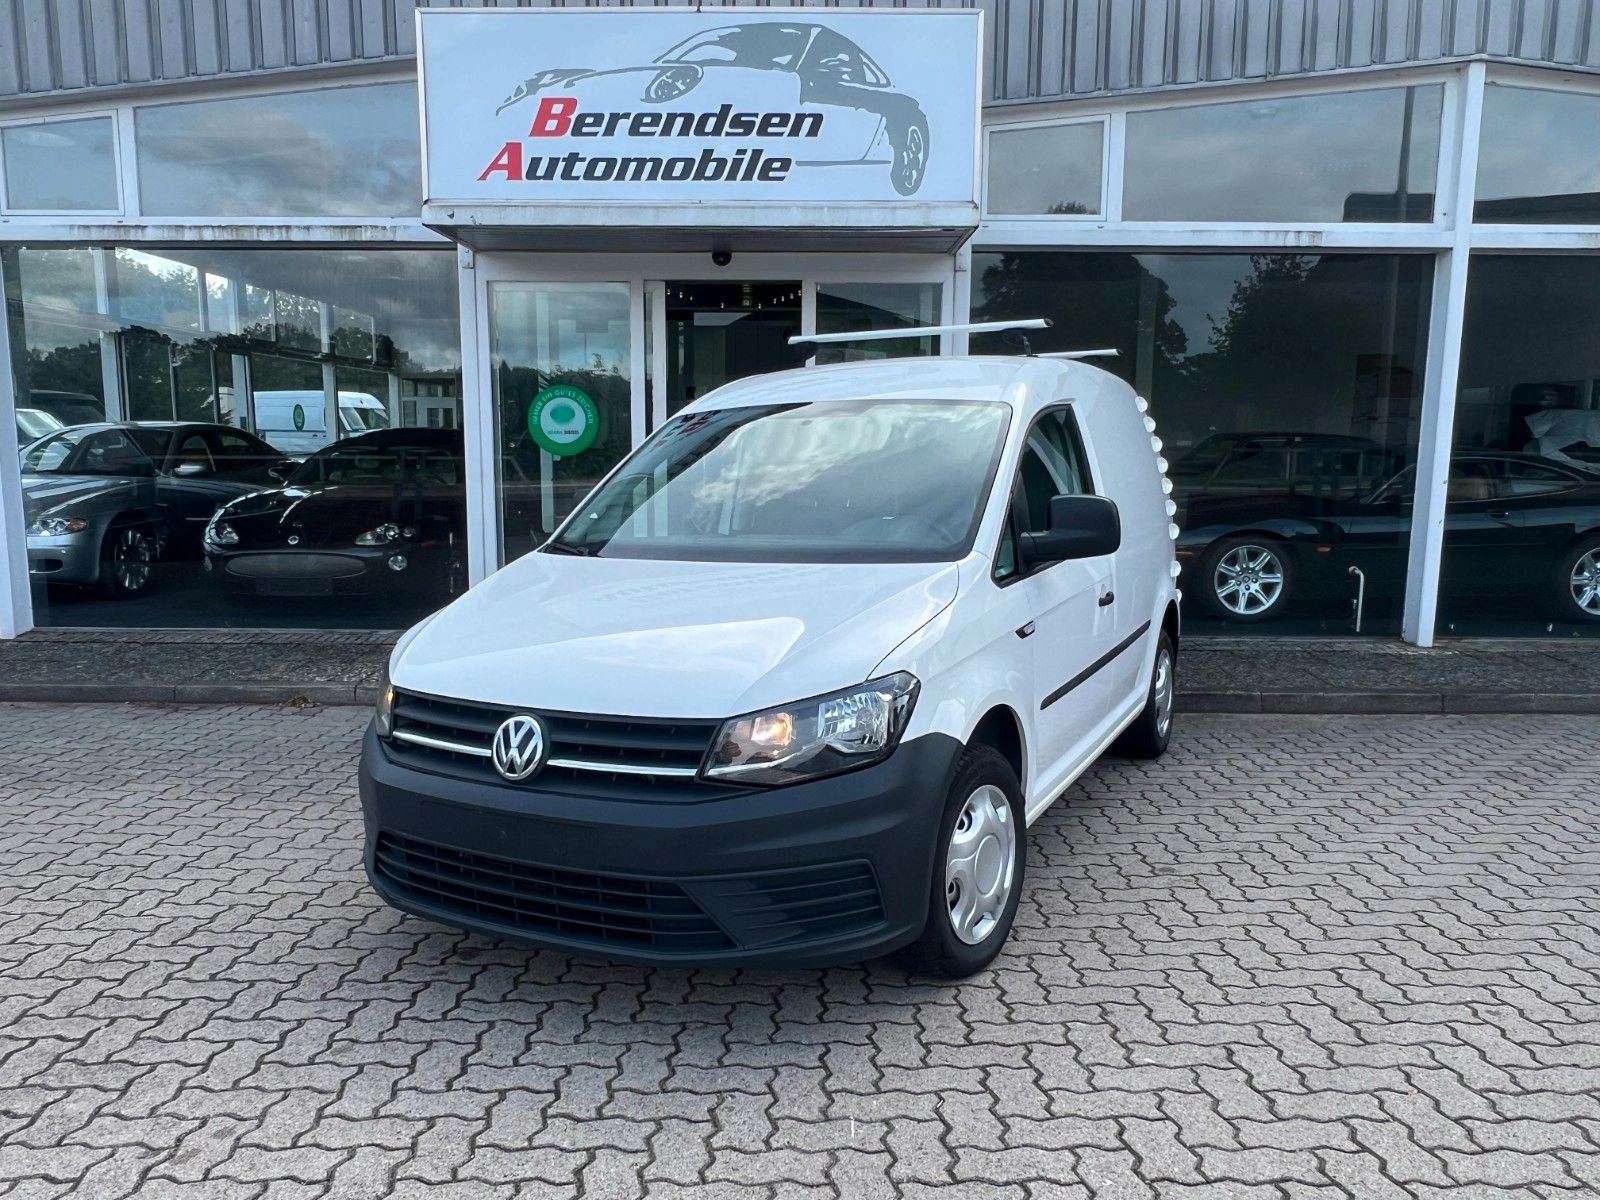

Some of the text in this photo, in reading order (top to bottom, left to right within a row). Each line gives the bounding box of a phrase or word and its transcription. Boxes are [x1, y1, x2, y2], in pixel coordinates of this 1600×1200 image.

[529, 97, 824, 137] Berendsen
[477, 142, 792, 181] Automobile
[495, 717, 542, 778] VW
